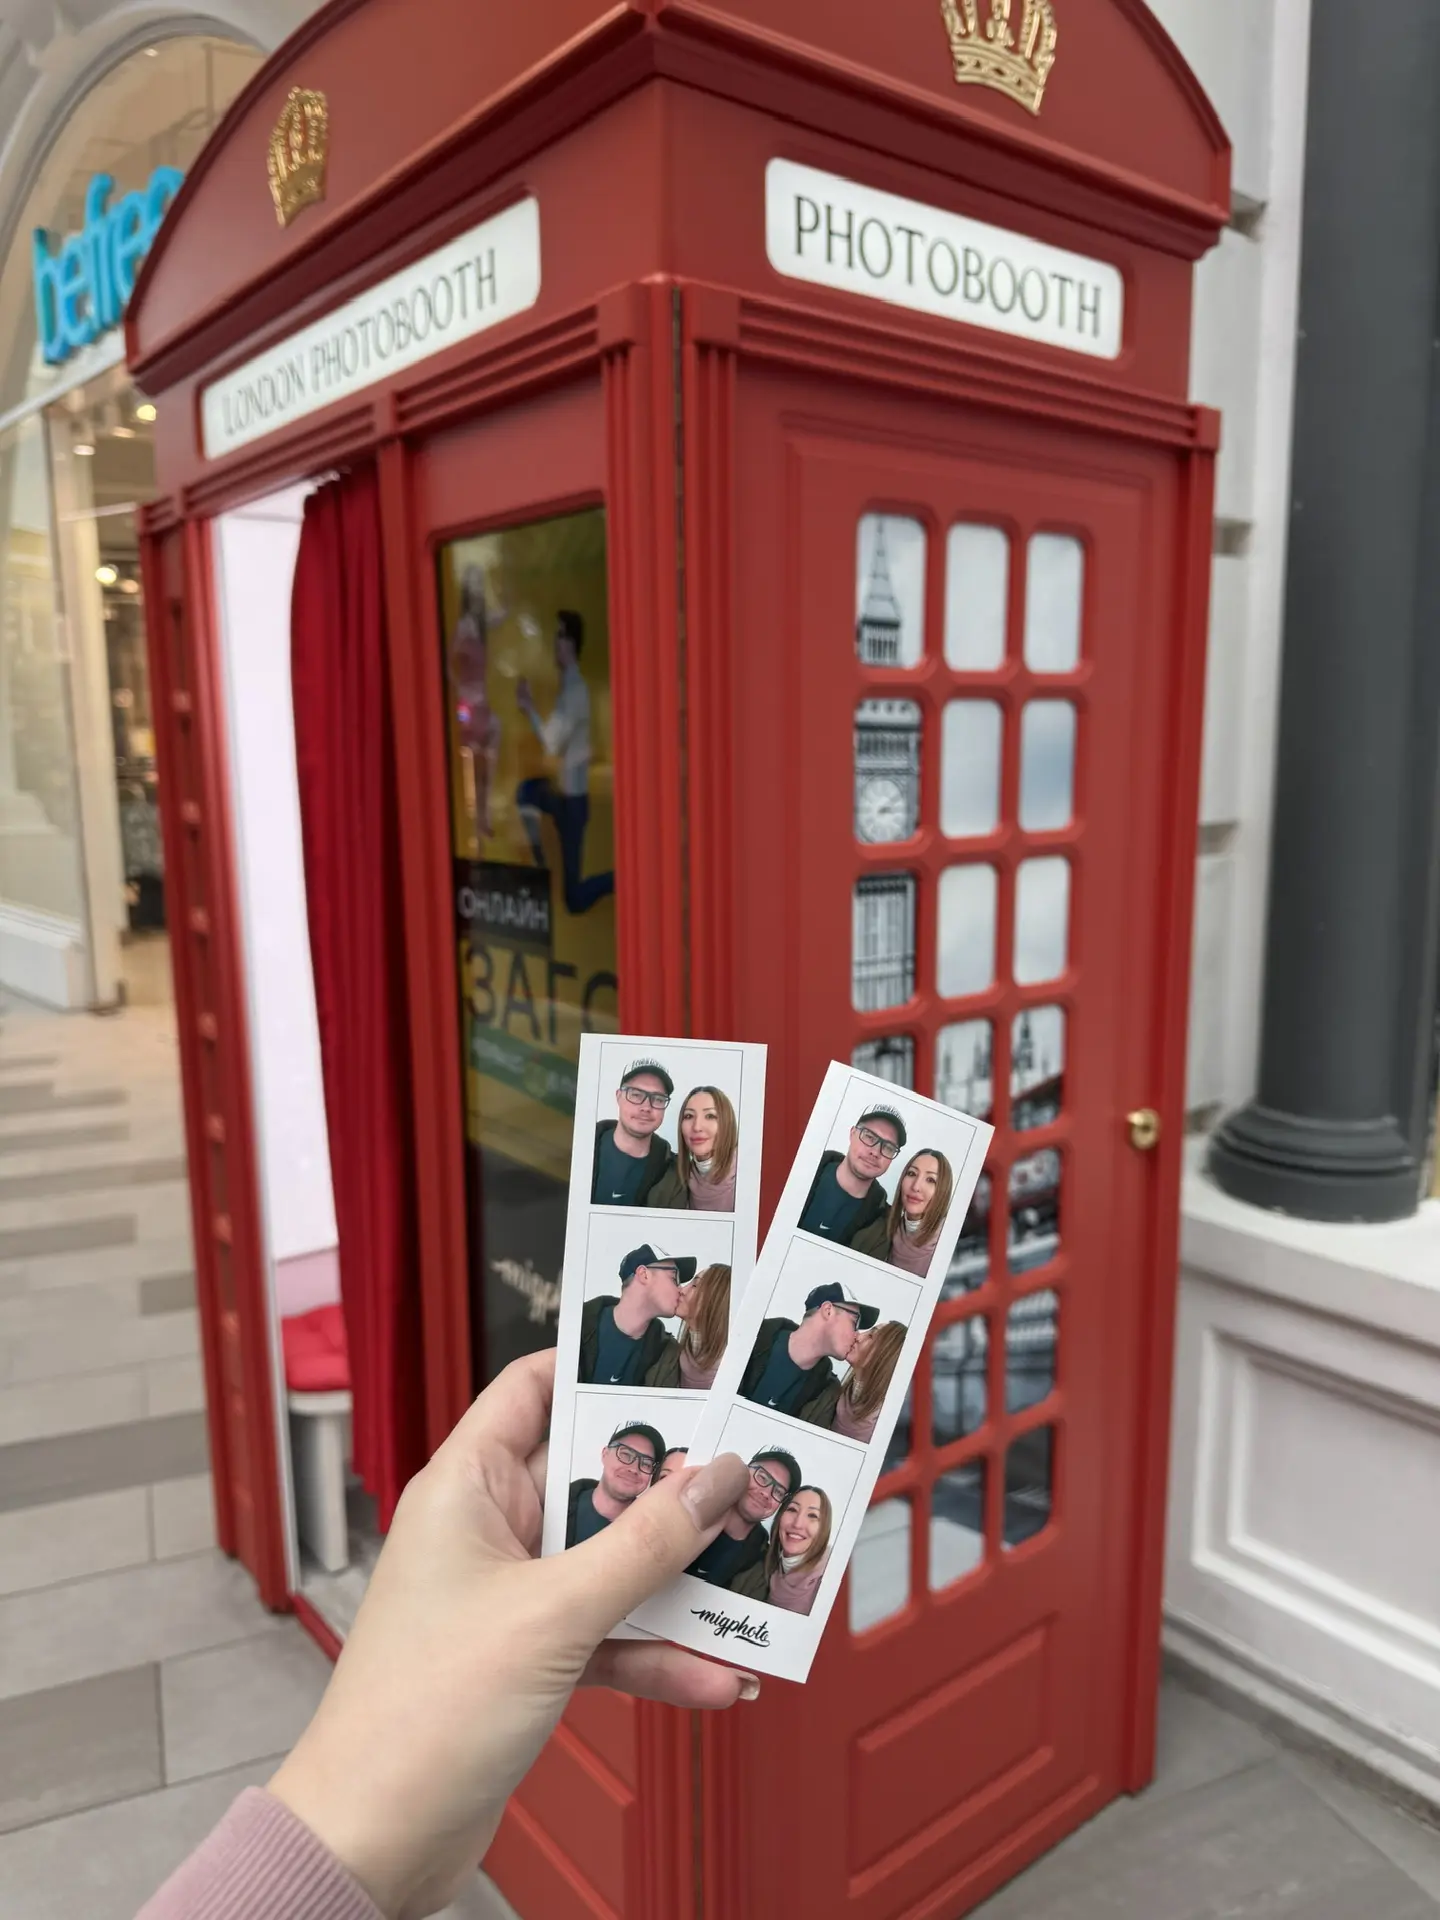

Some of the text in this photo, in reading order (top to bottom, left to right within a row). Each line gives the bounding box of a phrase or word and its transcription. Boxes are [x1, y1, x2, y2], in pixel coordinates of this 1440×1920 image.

[794, 195, 1101, 338] PHOTOBOOTH
[221, 247, 497, 437] LONDON PHOTOBOOTH
[458, 886, 550, 932] ОНЛАЙН
[690, 1608, 771, 1648] migphoto
